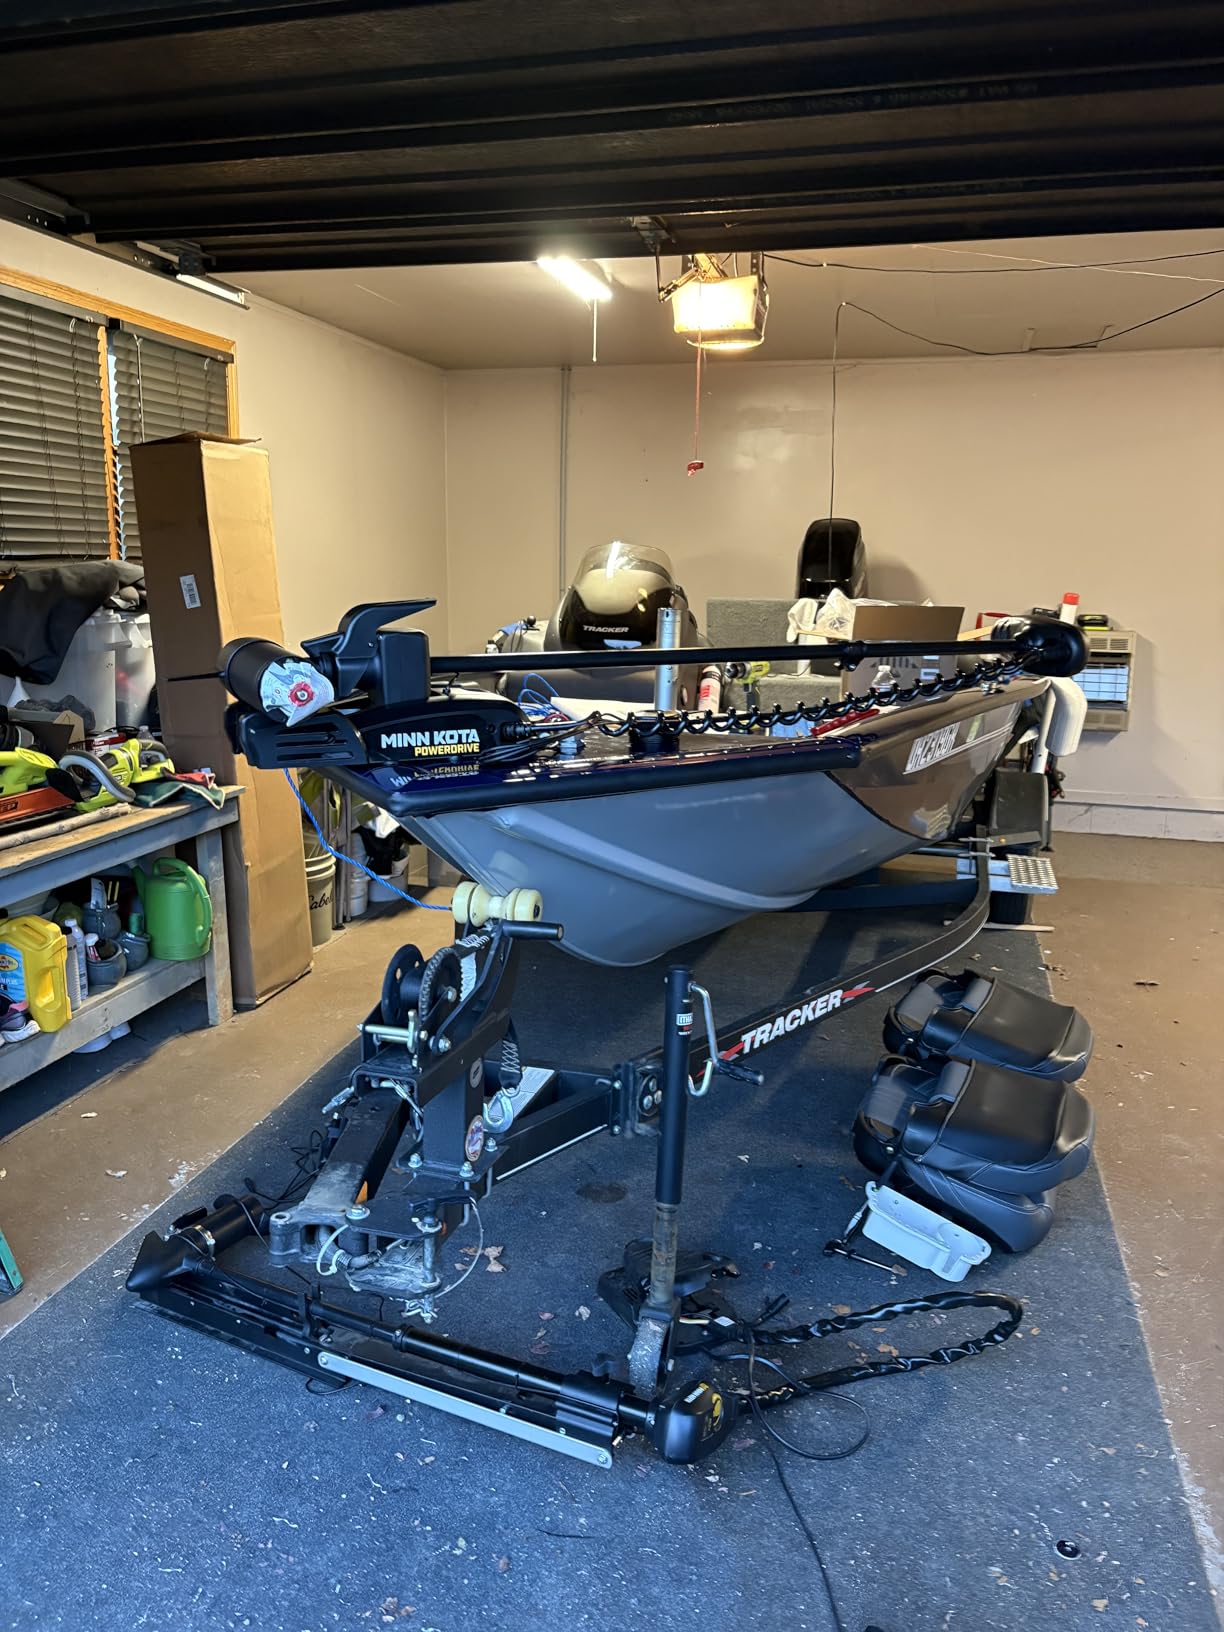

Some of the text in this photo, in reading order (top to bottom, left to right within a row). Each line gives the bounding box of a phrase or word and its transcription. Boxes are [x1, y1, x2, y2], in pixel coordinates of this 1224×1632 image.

[583, 625, 629, 633] TRACKER
[381, 729, 480, 748] MINN KOTA
[414, 743, 480, 757] POWERDRIVE
[741, 989, 843, 1053] TRACKER
